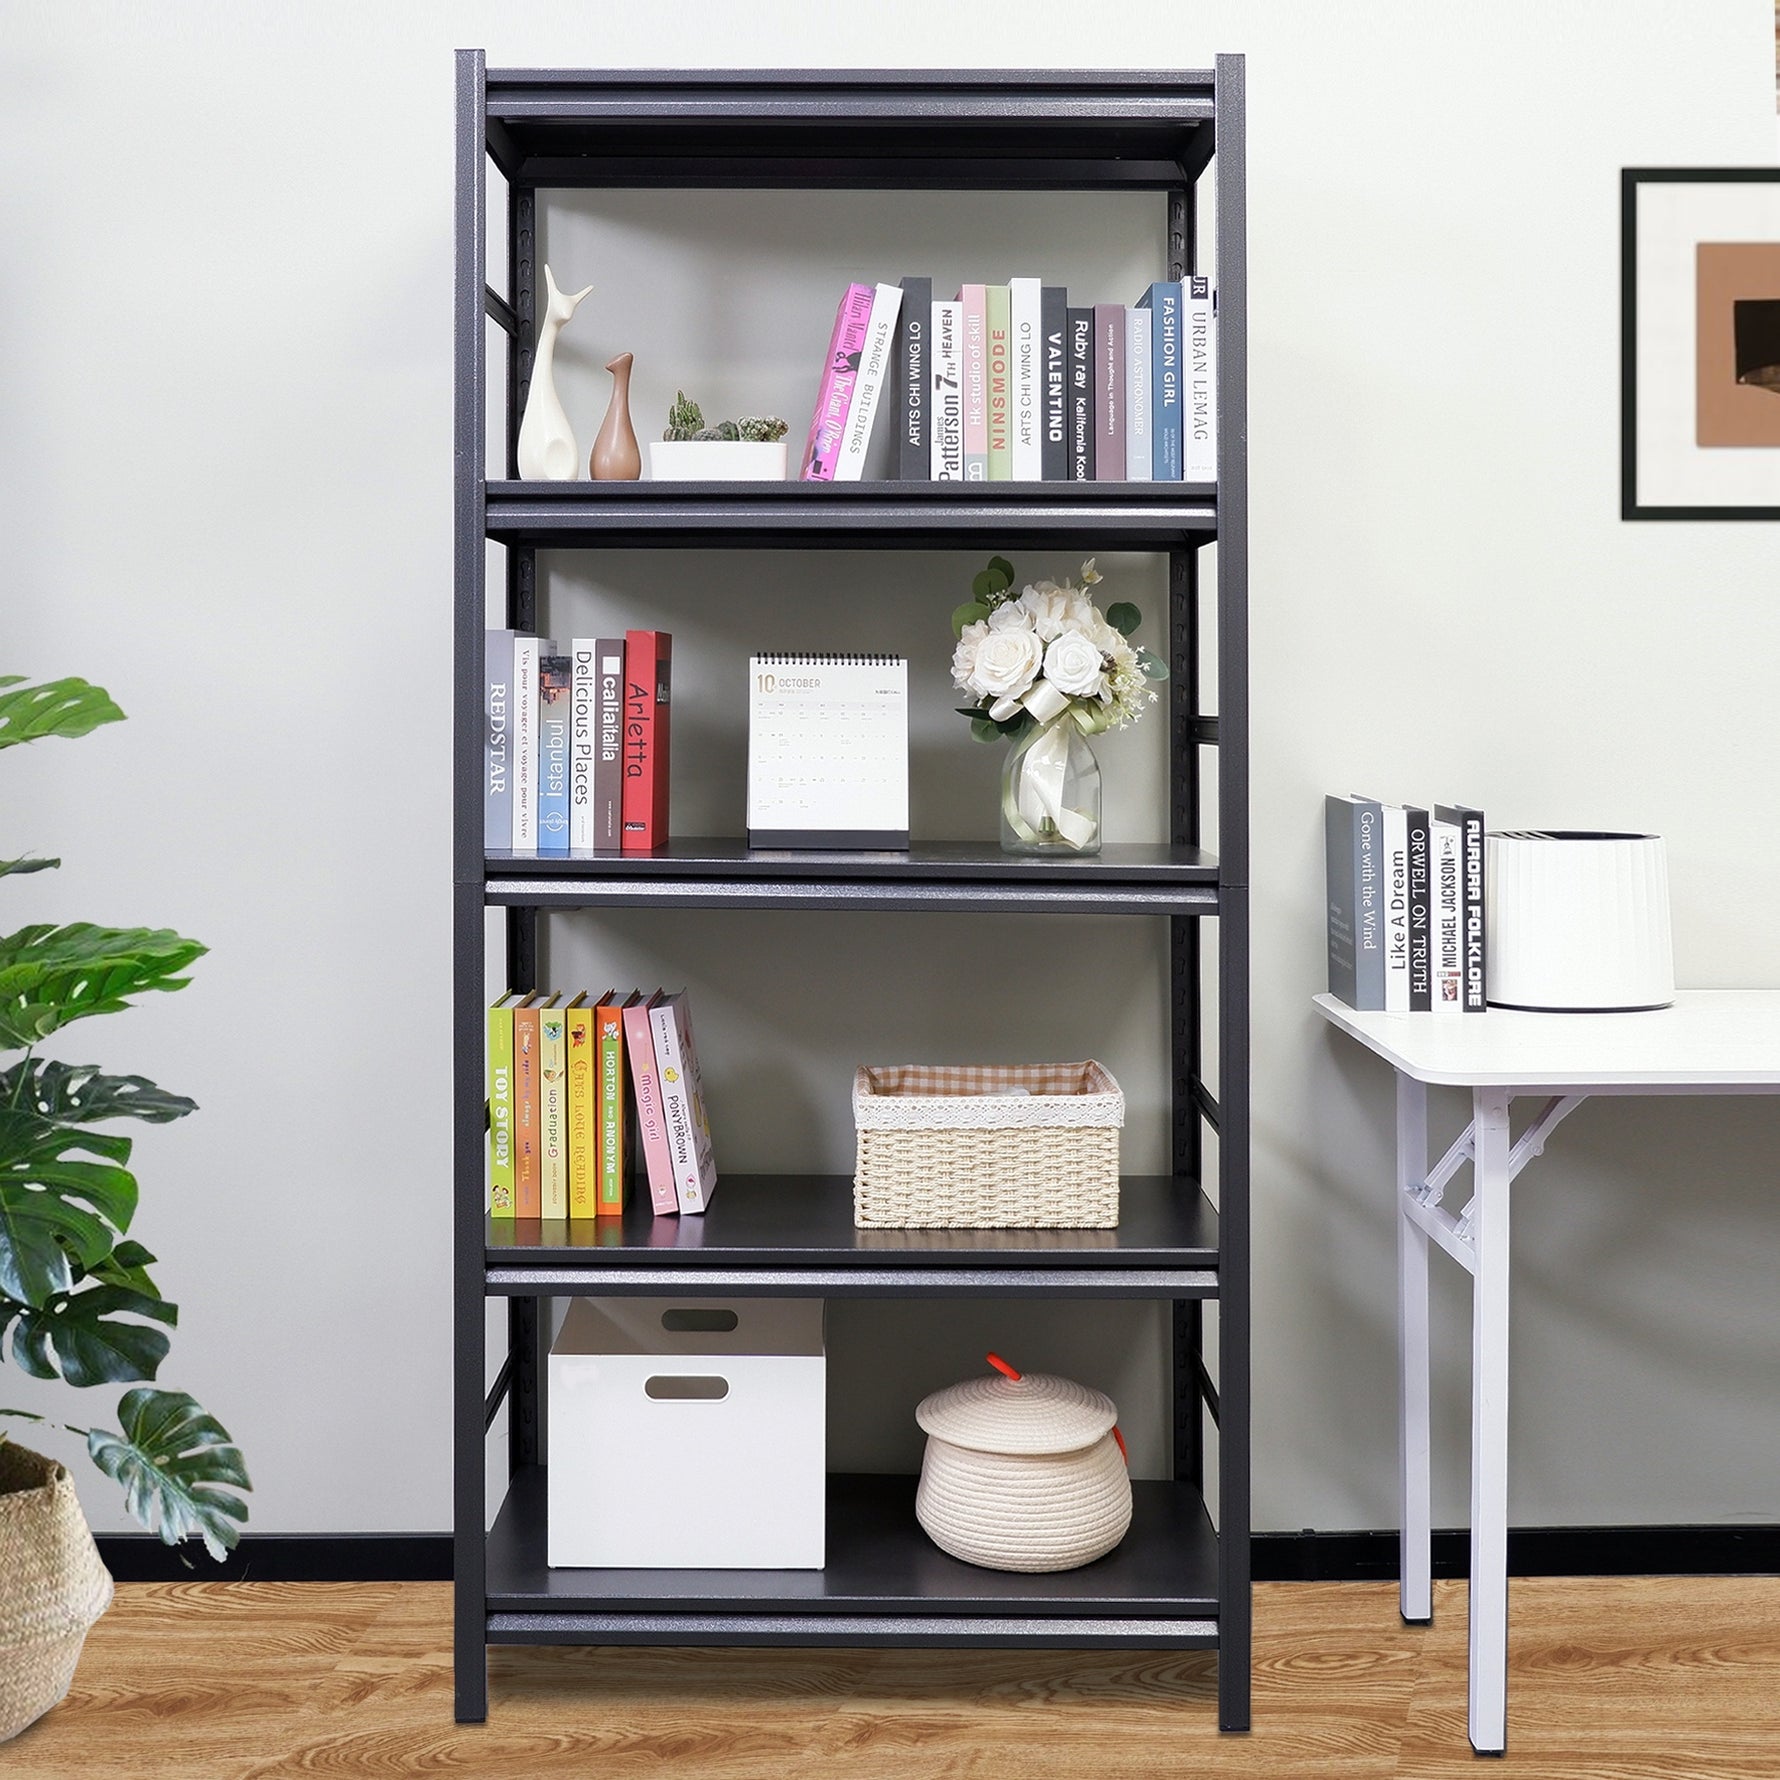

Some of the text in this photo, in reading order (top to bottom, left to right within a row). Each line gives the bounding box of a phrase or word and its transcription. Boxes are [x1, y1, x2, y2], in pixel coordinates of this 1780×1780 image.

[843, 322, 865, 352] Mantel
[942, 309, 952, 358] HEAVEN
[1075, 320, 1088, 360] Ruby
[1163, 297, 1175, 407] FASHION GIRL
[833, 375, 852, 392] The
[850, 322, 888, 454] STRANGE BUILDINGS
[909, 321, 921, 446] ARTS CHI WING LO
[968, 314, 980, 425] Hk studio of skill
[993, 329, 1005, 449] NINSMODE
[1020, 322, 1031, 445] ARTS CHI WING LO
[1049, 332, 1062, 442] VALENTINO
[1075, 364, 1085, 389] ray
[1108, 393, 1114, 401] in
[1134, 318, 1144, 436] RADIO ASTRONOMER
[1192, 312, 1208, 440] URBAN LEMAG
[935, 416, 944, 446] James
[939, 394, 959, 481] Patterson
[1076, 397, 1086, 453] Kalifornia
[521, 650, 529, 665] Vis
[758, 674, 775, 693] 10
[779, 678, 821, 688] OCTOBER
[490, 683, 505, 795] REDSTAR
[520, 695, 528, 733] voyager
[521, 736, 528, 746] et
[575, 651, 592, 805] Delicious Places
[602, 677, 620, 761] caliaitalia
[627, 683, 650, 777] Arletta
[520, 748, 528, 784] voyage
[1361, 812, 1376, 950] Gone with the Wind
[1391, 850, 1406, 970] Like A Dream
[1411, 829, 1427, 994] ORWELL ON TRUTH
[1441, 858, 1456, 911] JACKSON
[1467, 820, 1481, 1006] AURORA FOLKLORE
[1441, 916, 1456, 967] MICHAEL
[606, 1051, 615, 1101] HORTON
[641, 1075, 659, 1141] Magic girl
[496, 1066, 509, 1168] TOY STORY
[548, 1089, 558, 1158] Graduation
[607, 1121, 616, 1173] ANONYM
[668, 1095, 687, 1164] PONYBROWN
